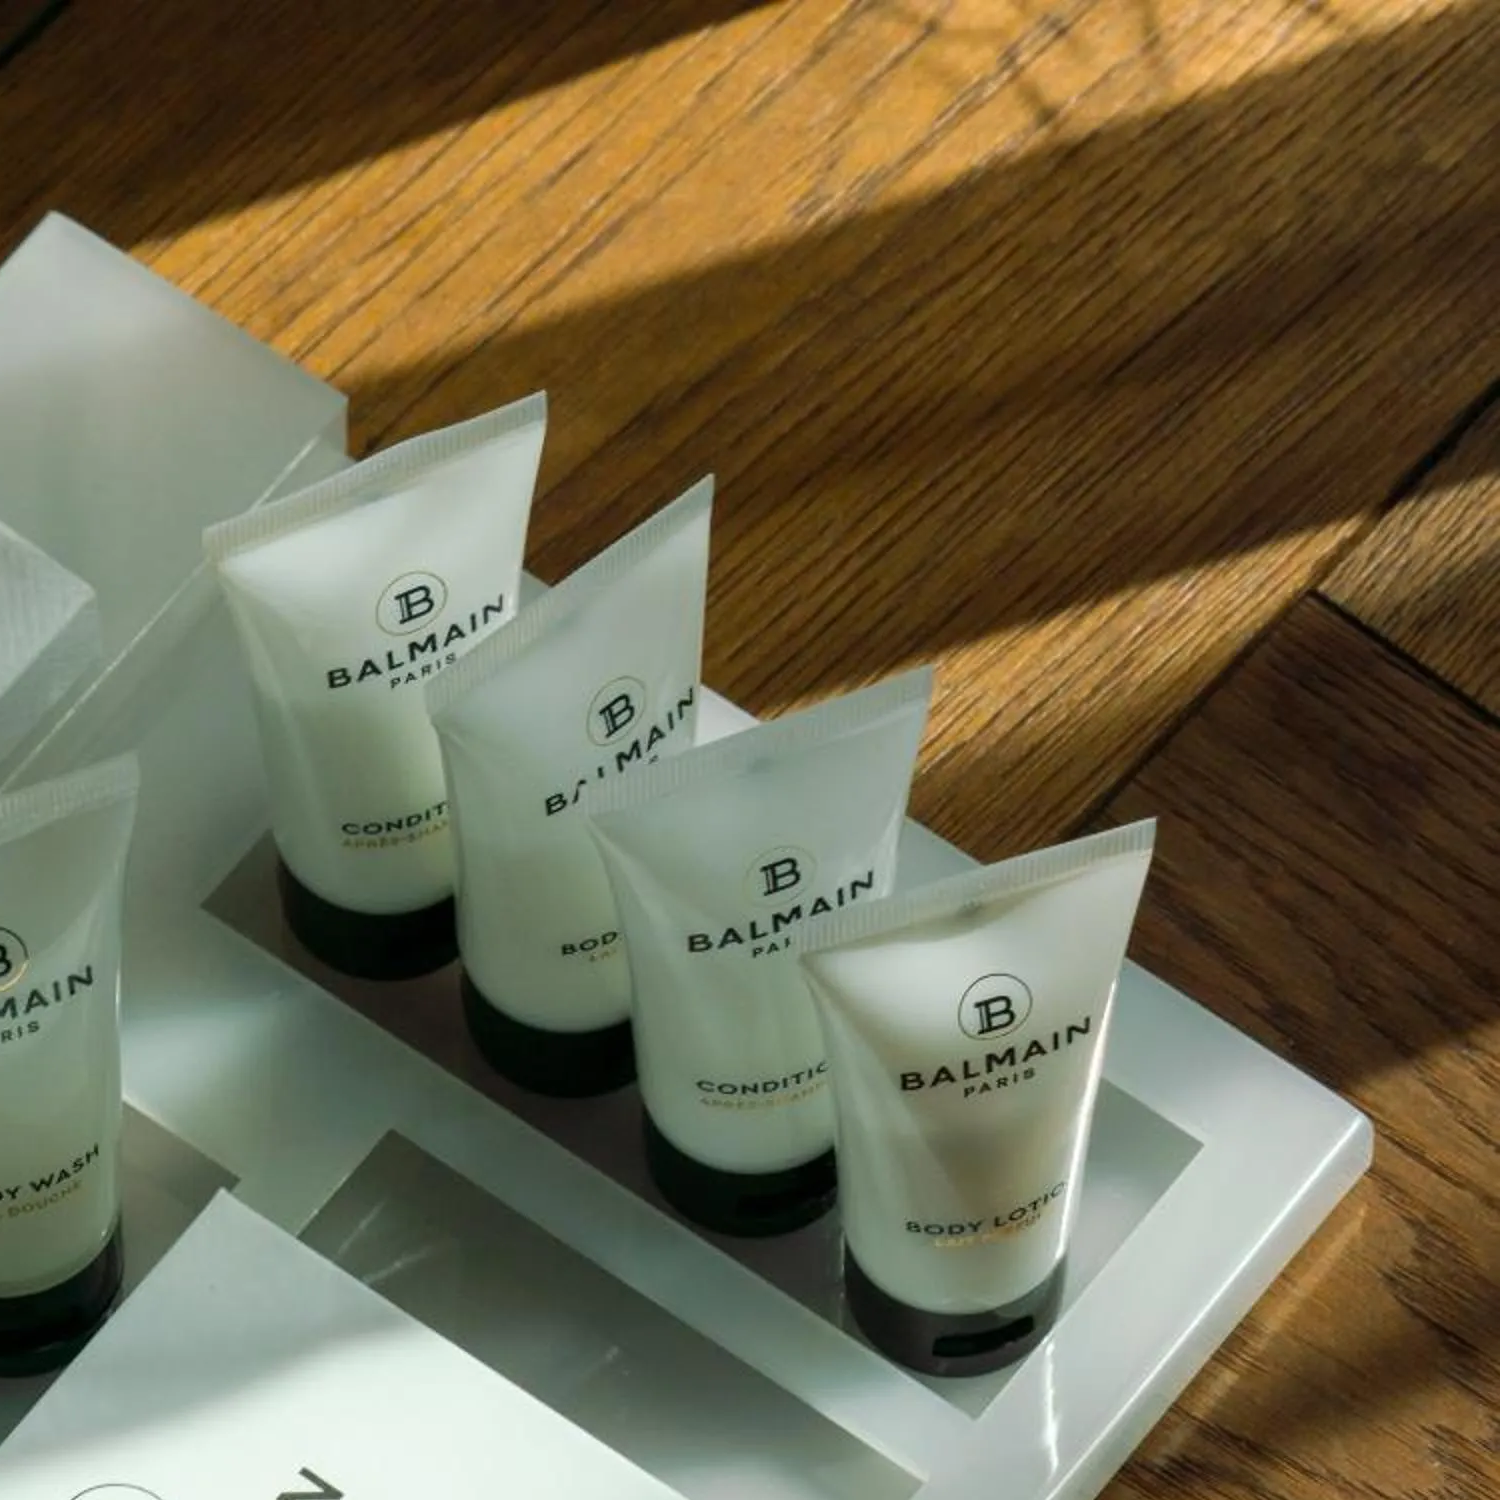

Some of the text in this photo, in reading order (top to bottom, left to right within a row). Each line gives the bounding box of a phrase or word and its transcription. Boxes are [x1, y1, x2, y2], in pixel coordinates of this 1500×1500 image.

[326, 592, 505, 689] BALMAIN
[390, 651, 457, 690] PARIS
[341, 799, 451, 836] CONDIT
[686, 869, 875, 953] BALMAIN
[561, 930, 619, 957] BOD
[900, 1015, 1092, 1091] BALMAIN
[695, 1059, 830, 1096] CONDITIO
[964, 1066, 1036, 1098] PARIS
[29, 1142, 100, 1193] WASH
[905, 1218, 984, 1236] BODY
[993, 1180, 1067, 1228] LOTIO
